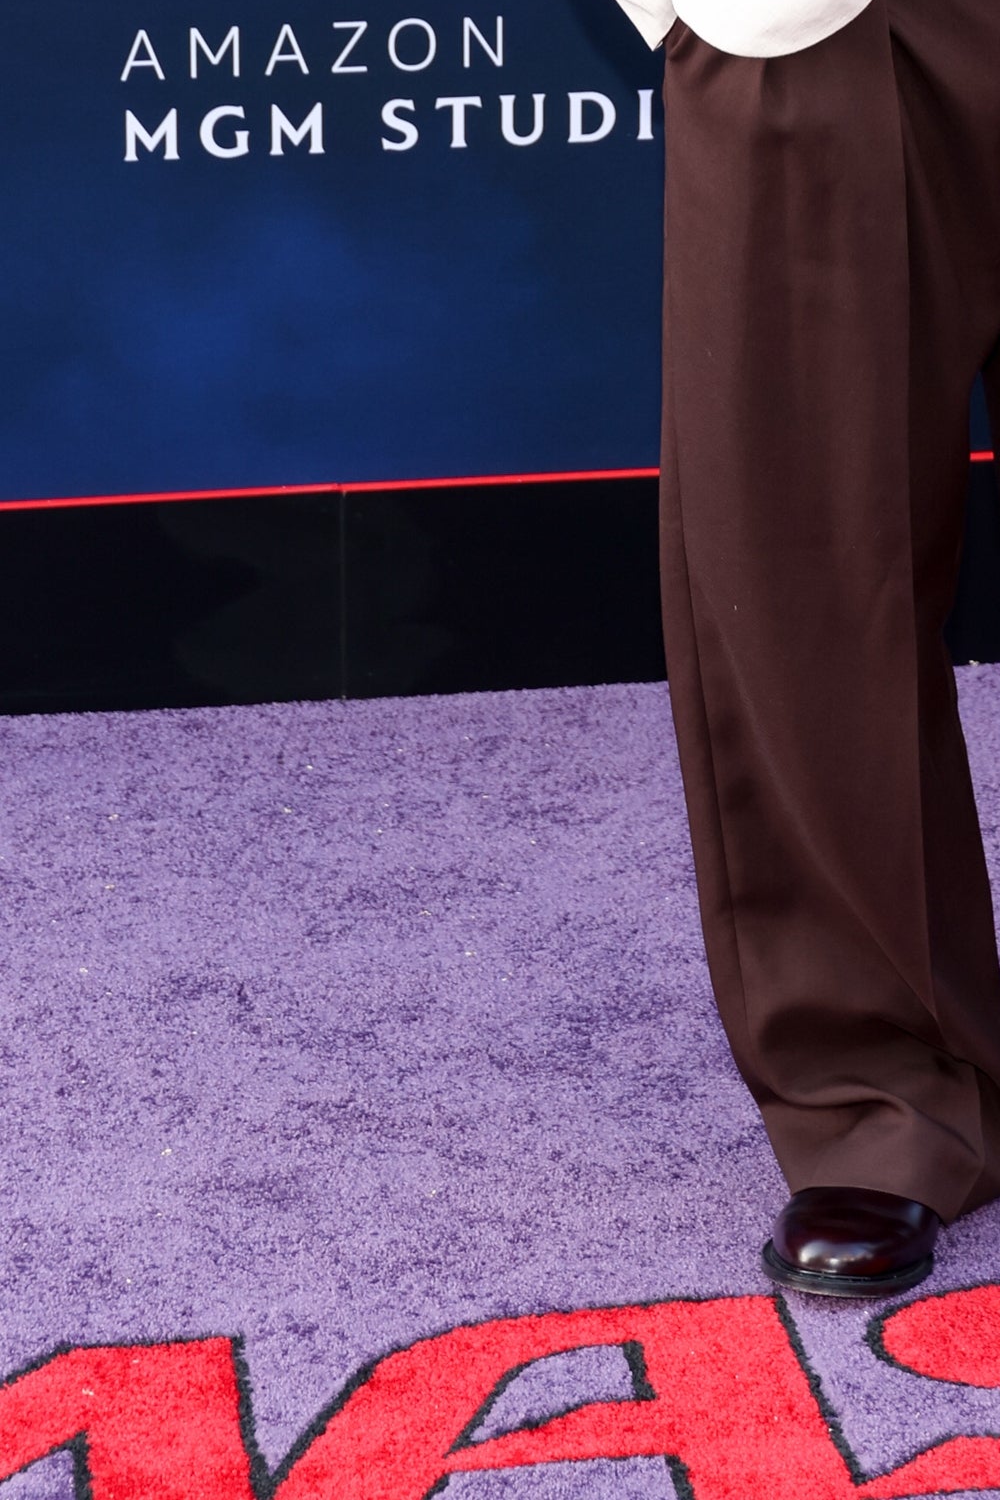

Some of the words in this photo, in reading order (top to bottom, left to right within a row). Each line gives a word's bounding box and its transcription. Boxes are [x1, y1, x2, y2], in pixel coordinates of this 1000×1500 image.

[120, 15, 504, 82] AMAZON
[124, 102, 326, 162] MGM
[381, 89, 655, 151] STUDI
